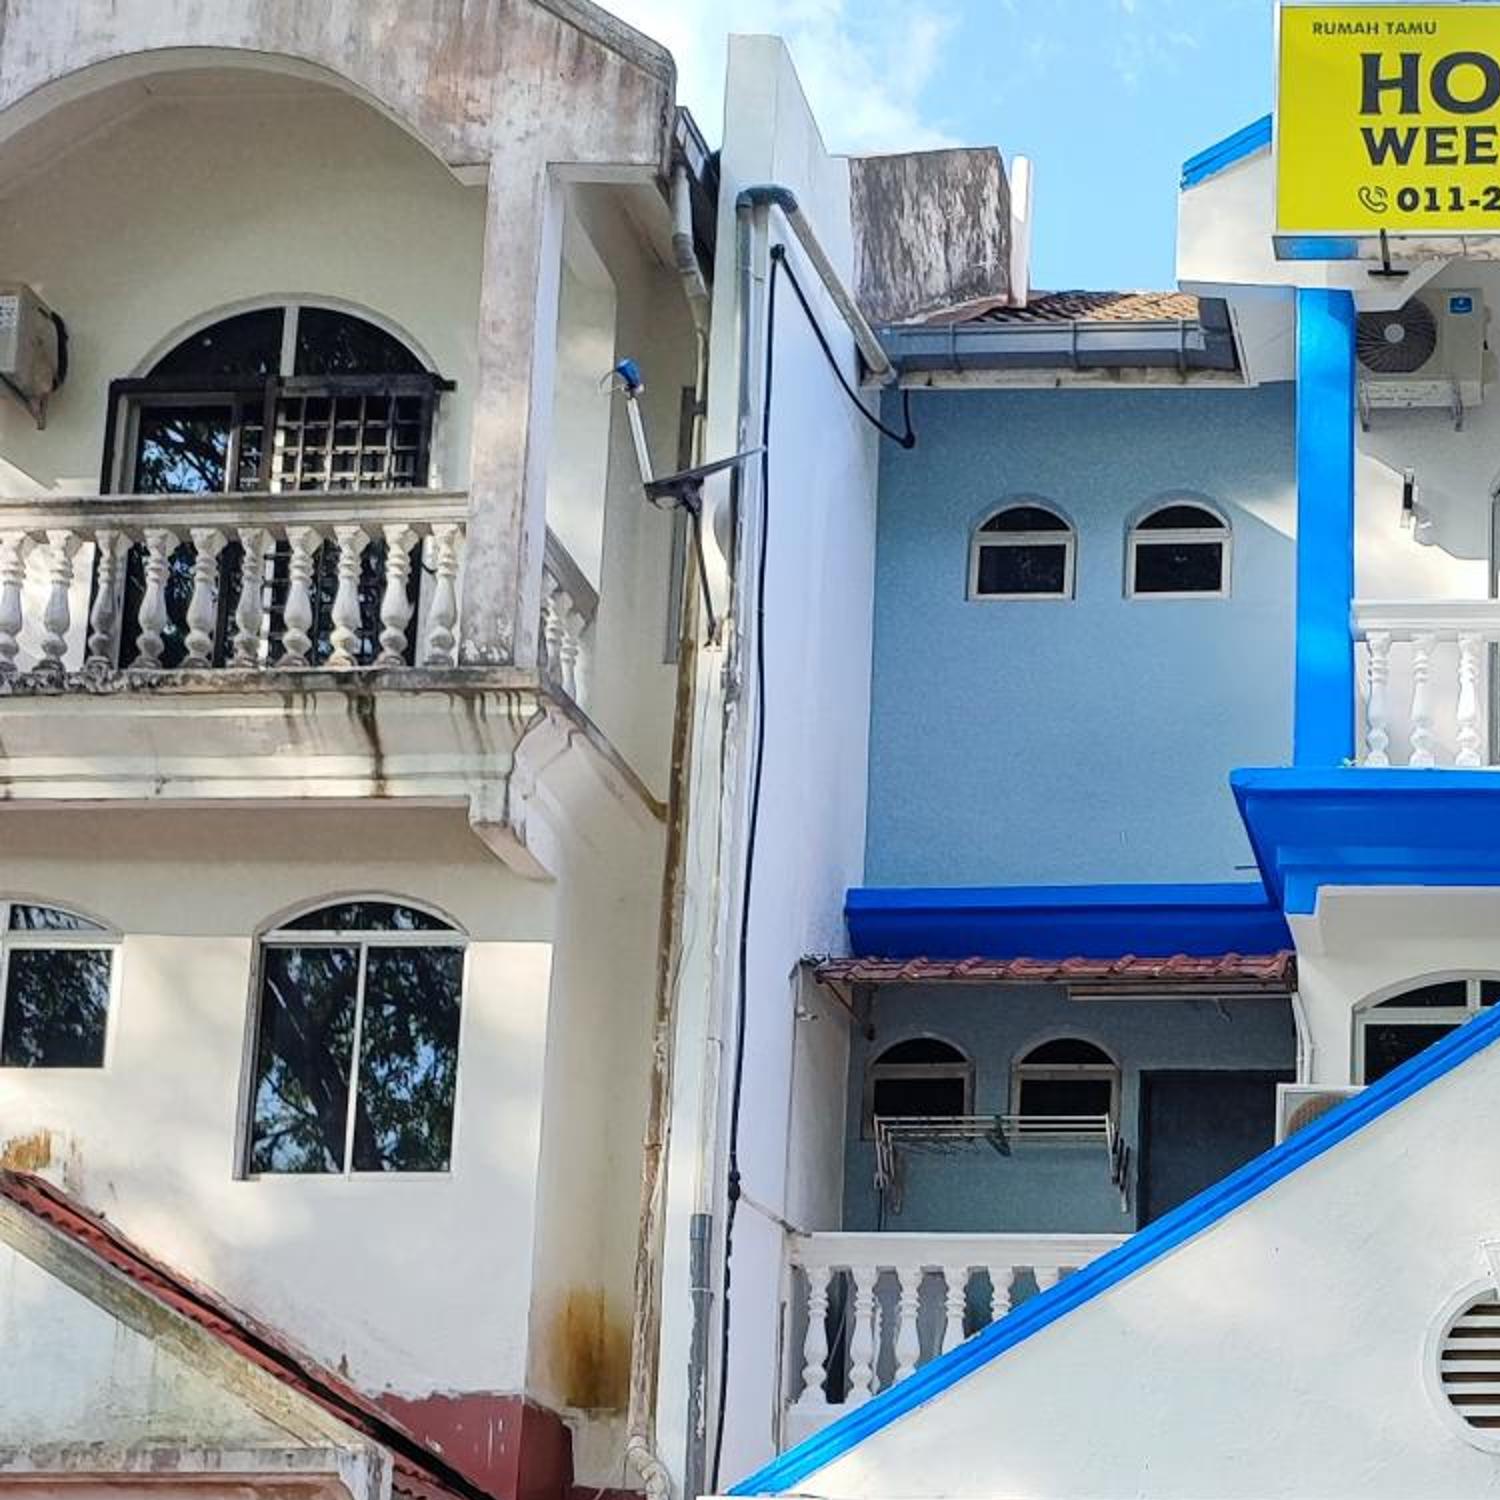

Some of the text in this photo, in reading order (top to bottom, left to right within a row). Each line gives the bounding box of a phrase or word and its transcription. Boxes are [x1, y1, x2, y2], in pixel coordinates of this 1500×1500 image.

[1312, 22, 1437, 35] RUMAH TAMU
[1360, 126, 1498, 166] WEE
